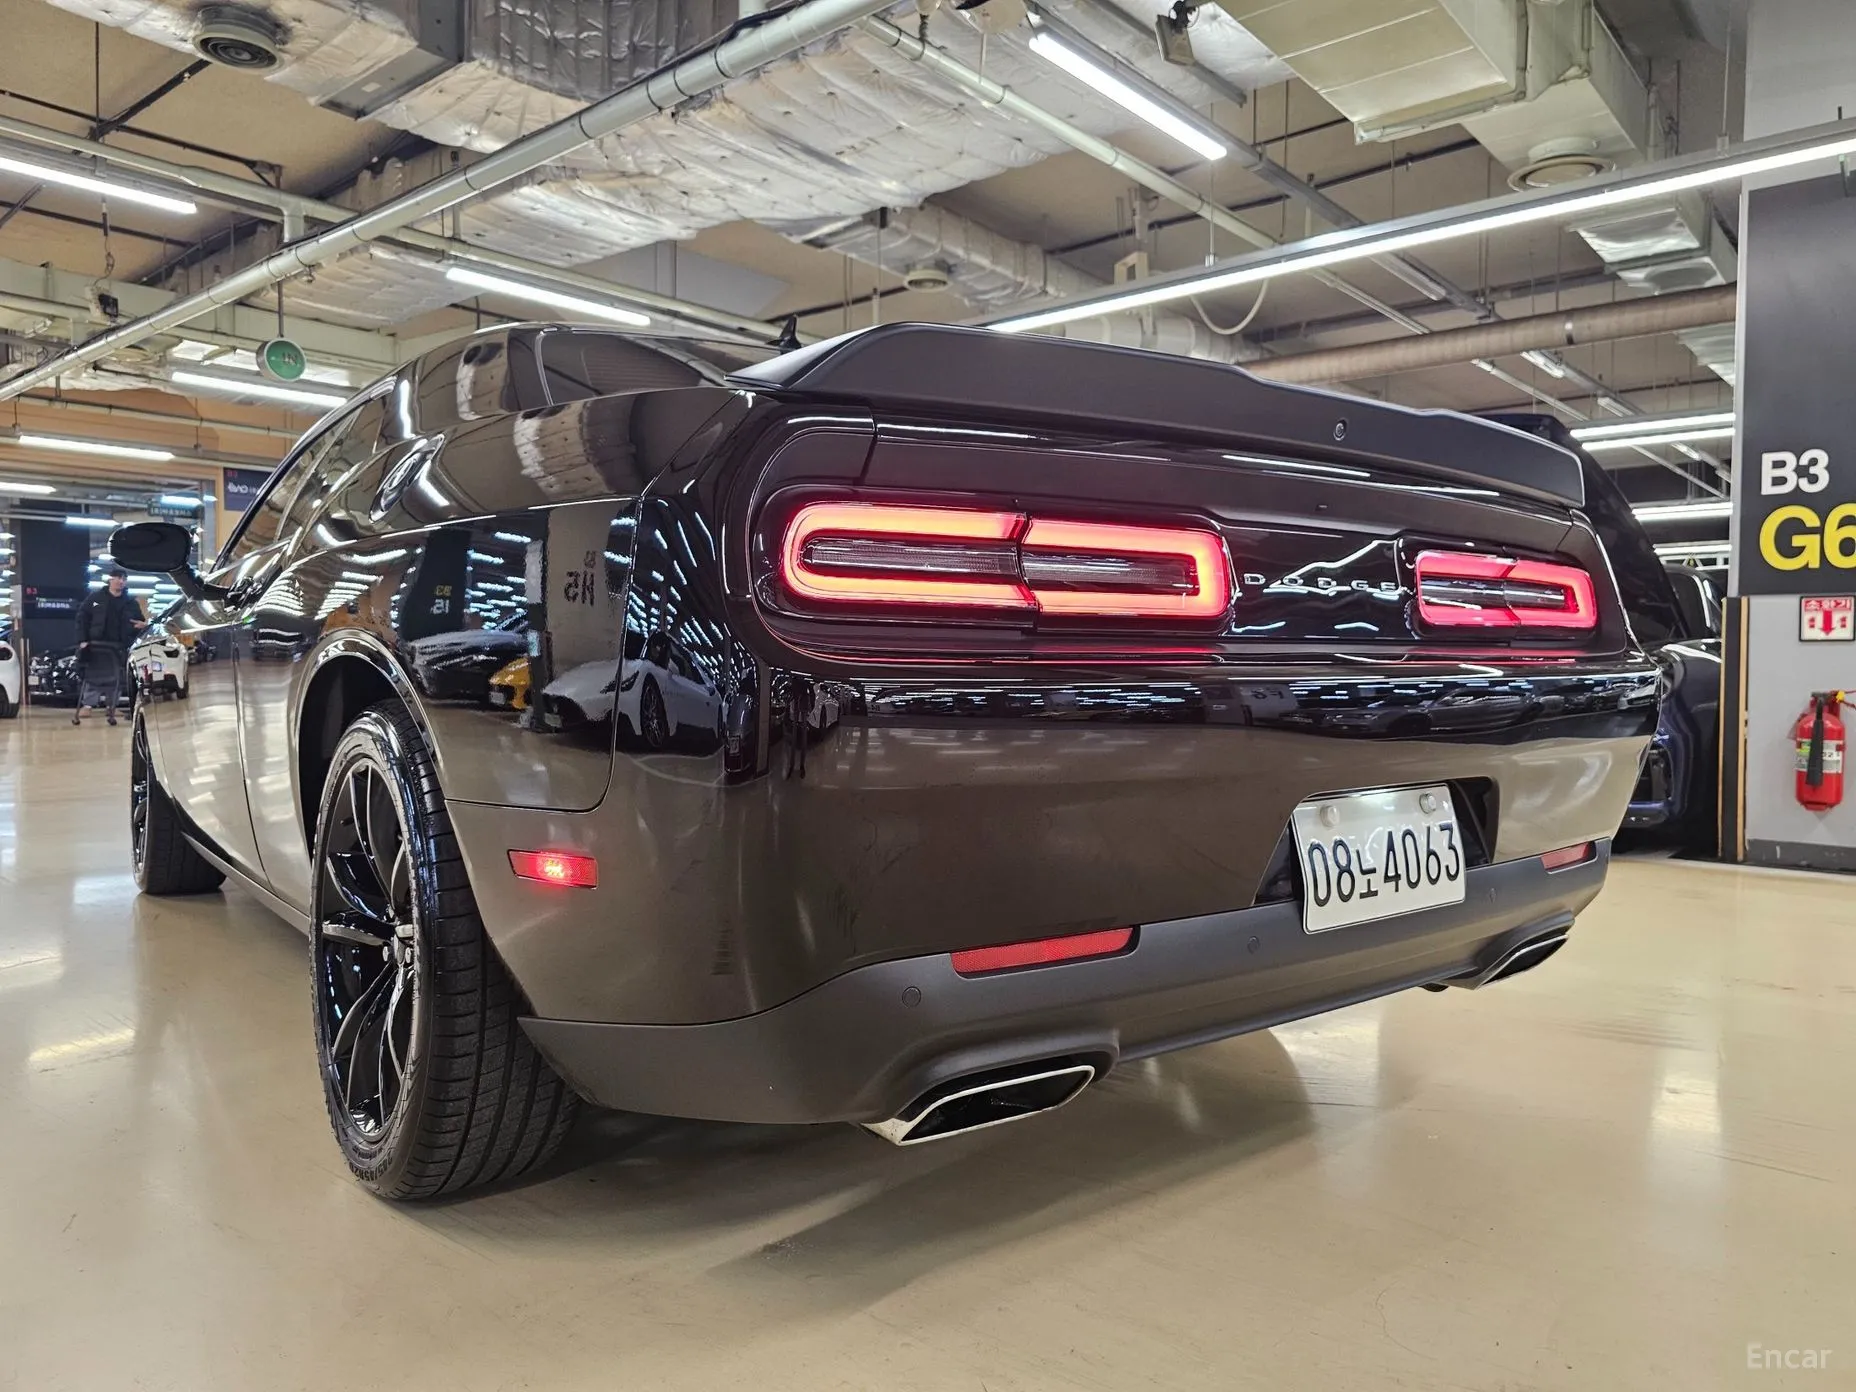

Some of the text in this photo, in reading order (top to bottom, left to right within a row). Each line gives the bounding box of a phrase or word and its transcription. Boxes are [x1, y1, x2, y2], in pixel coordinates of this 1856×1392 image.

[1760, 448, 1829, 496] B3
[1759, 503, 1856, 571] G6
[1243, 573, 1397, 591] DODGE
